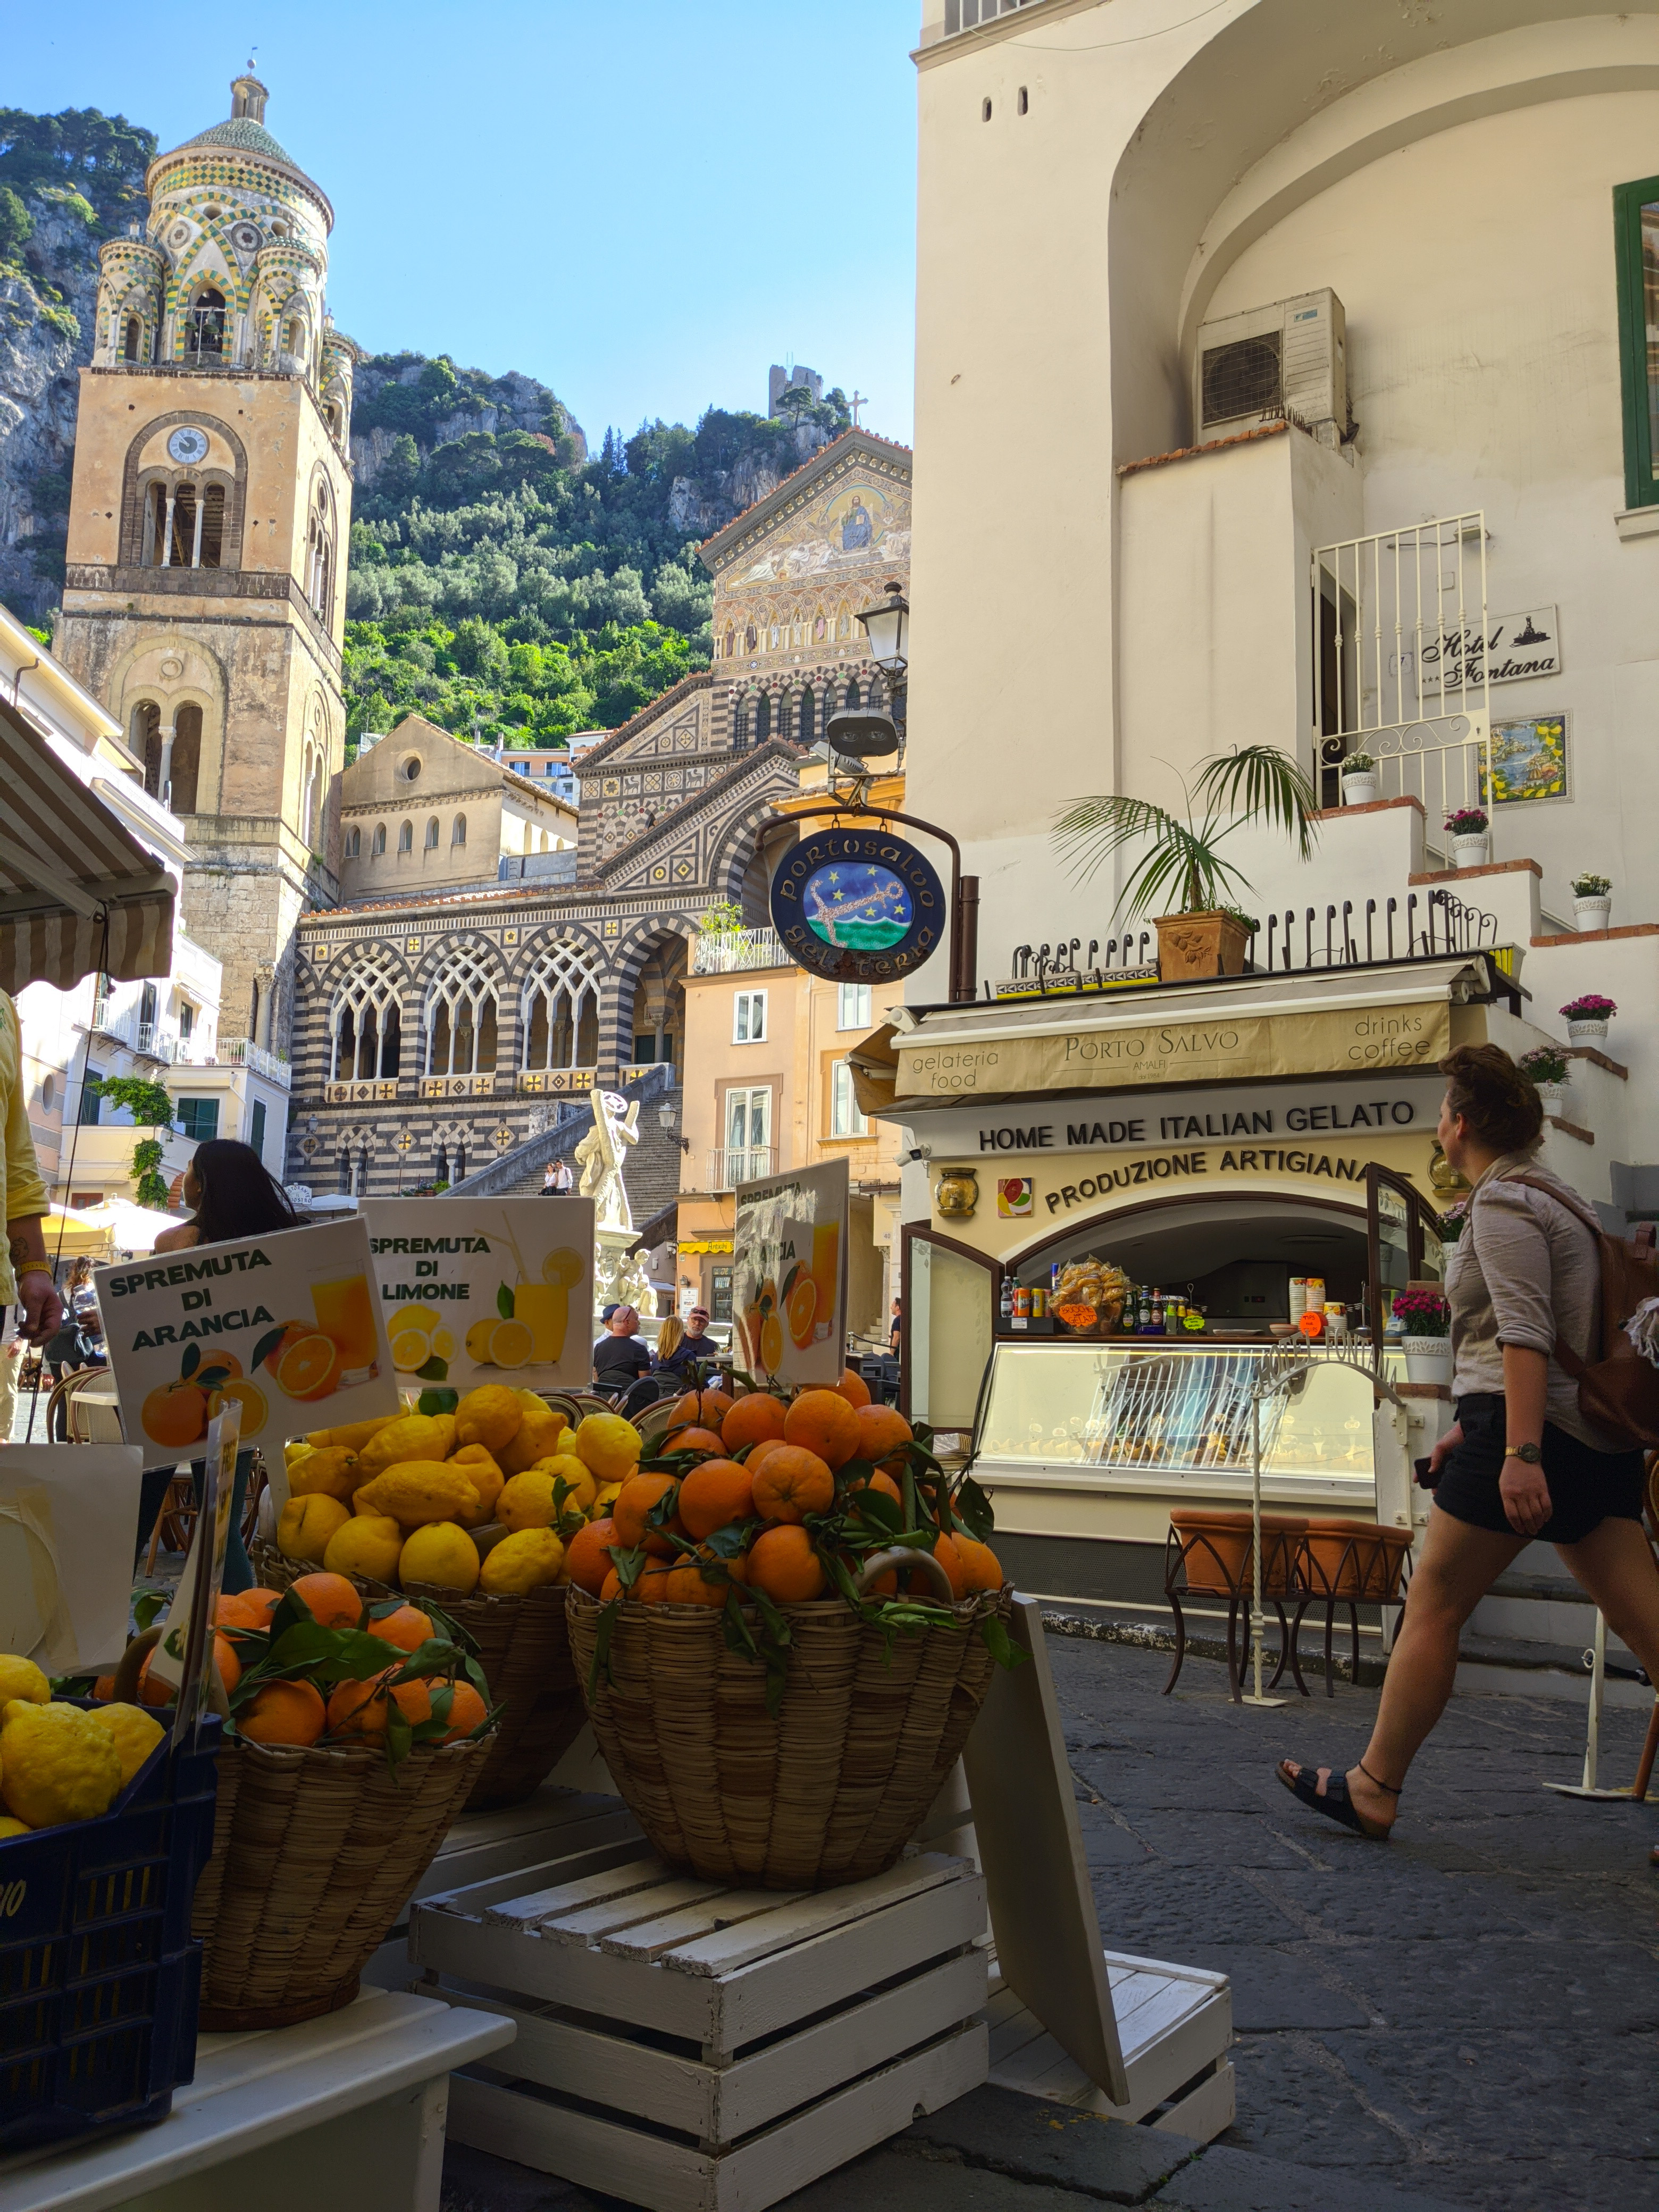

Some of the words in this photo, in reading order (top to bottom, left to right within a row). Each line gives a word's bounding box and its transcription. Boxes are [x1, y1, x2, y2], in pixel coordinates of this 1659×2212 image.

[1422, 626, 1504, 663] Hotel
[1444, 655, 1554, 688] Fontana
[1355, 1014, 1422, 1036] drinks
[1065, 1036, 1145, 1061] PORTO
[1158, 1029, 1239, 1055] SALVO
[1348, 1037, 1430, 1060] coffee
[912, 1050, 999, 1074] gelateria
[1133, 1060, 1166, 1071] AMALFI
[931, 1069, 977, 1090] food
[979, 1125, 1054, 1152] HOME
[1066, 1119, 1145, 1146] MADE
[1160, 1110, 1273, 1141] ITALIAN
[1286, 1101, 1414, 1132] GELATO
[1045, 1151, 1207, 1214] PRODUZIONE
[369, 1237, 491, 1254] SPREMUTA
[708, 1242, 727, 1251] Antichi
[110, 1249, 272, 1298] SPREMUTA
[415, 1260, 438, 1276] DI
[182, 1287, 212, 1312] DI
[382, 1283, 470, 1300] LIMONE
[131, 1305, 275, 1351] ARANCIA
[1068, 1314, 1097, 1324] GELATO
[1255, 1329, 1318, 1395] HOTEL
[1323, 1326, 1397, 1394] FONTANA
